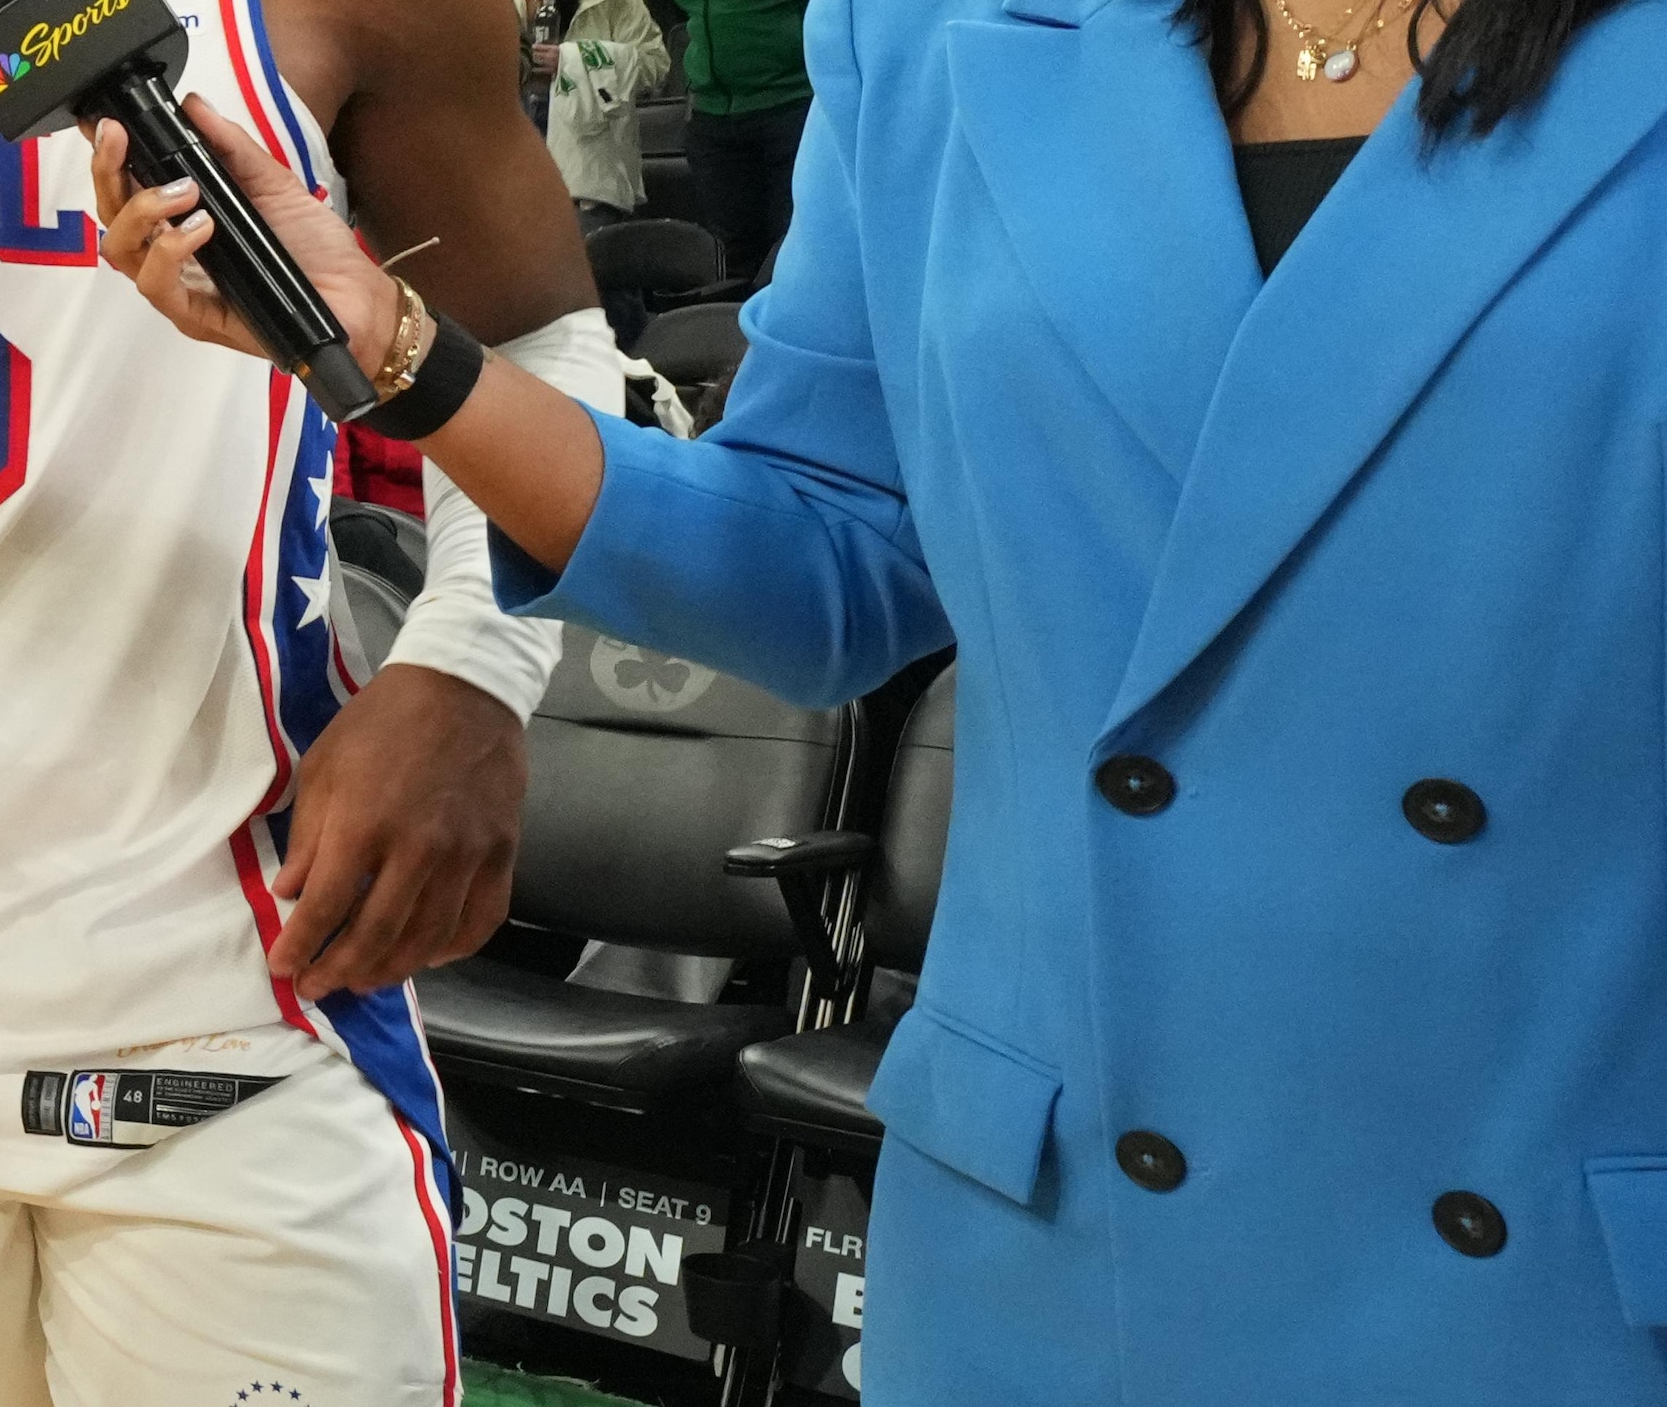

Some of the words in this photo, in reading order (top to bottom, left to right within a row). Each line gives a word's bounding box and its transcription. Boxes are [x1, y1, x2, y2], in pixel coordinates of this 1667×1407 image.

[122, 1089, 143, 1104] 48
[155, 1077, 233, 1093] ENGINEERED
[480, 1155, 545, 1188] ROW
[548, 1172, 587, 1199] AA
[618, 1186, 690, 1221] SEAT
[695, 1203, 712, 1226] 9
[456, 1185, 684, 1287] OSTON
[805, 1225, 863, 1260] FLR
[457, 1243, 660, 1338] ELTICS
